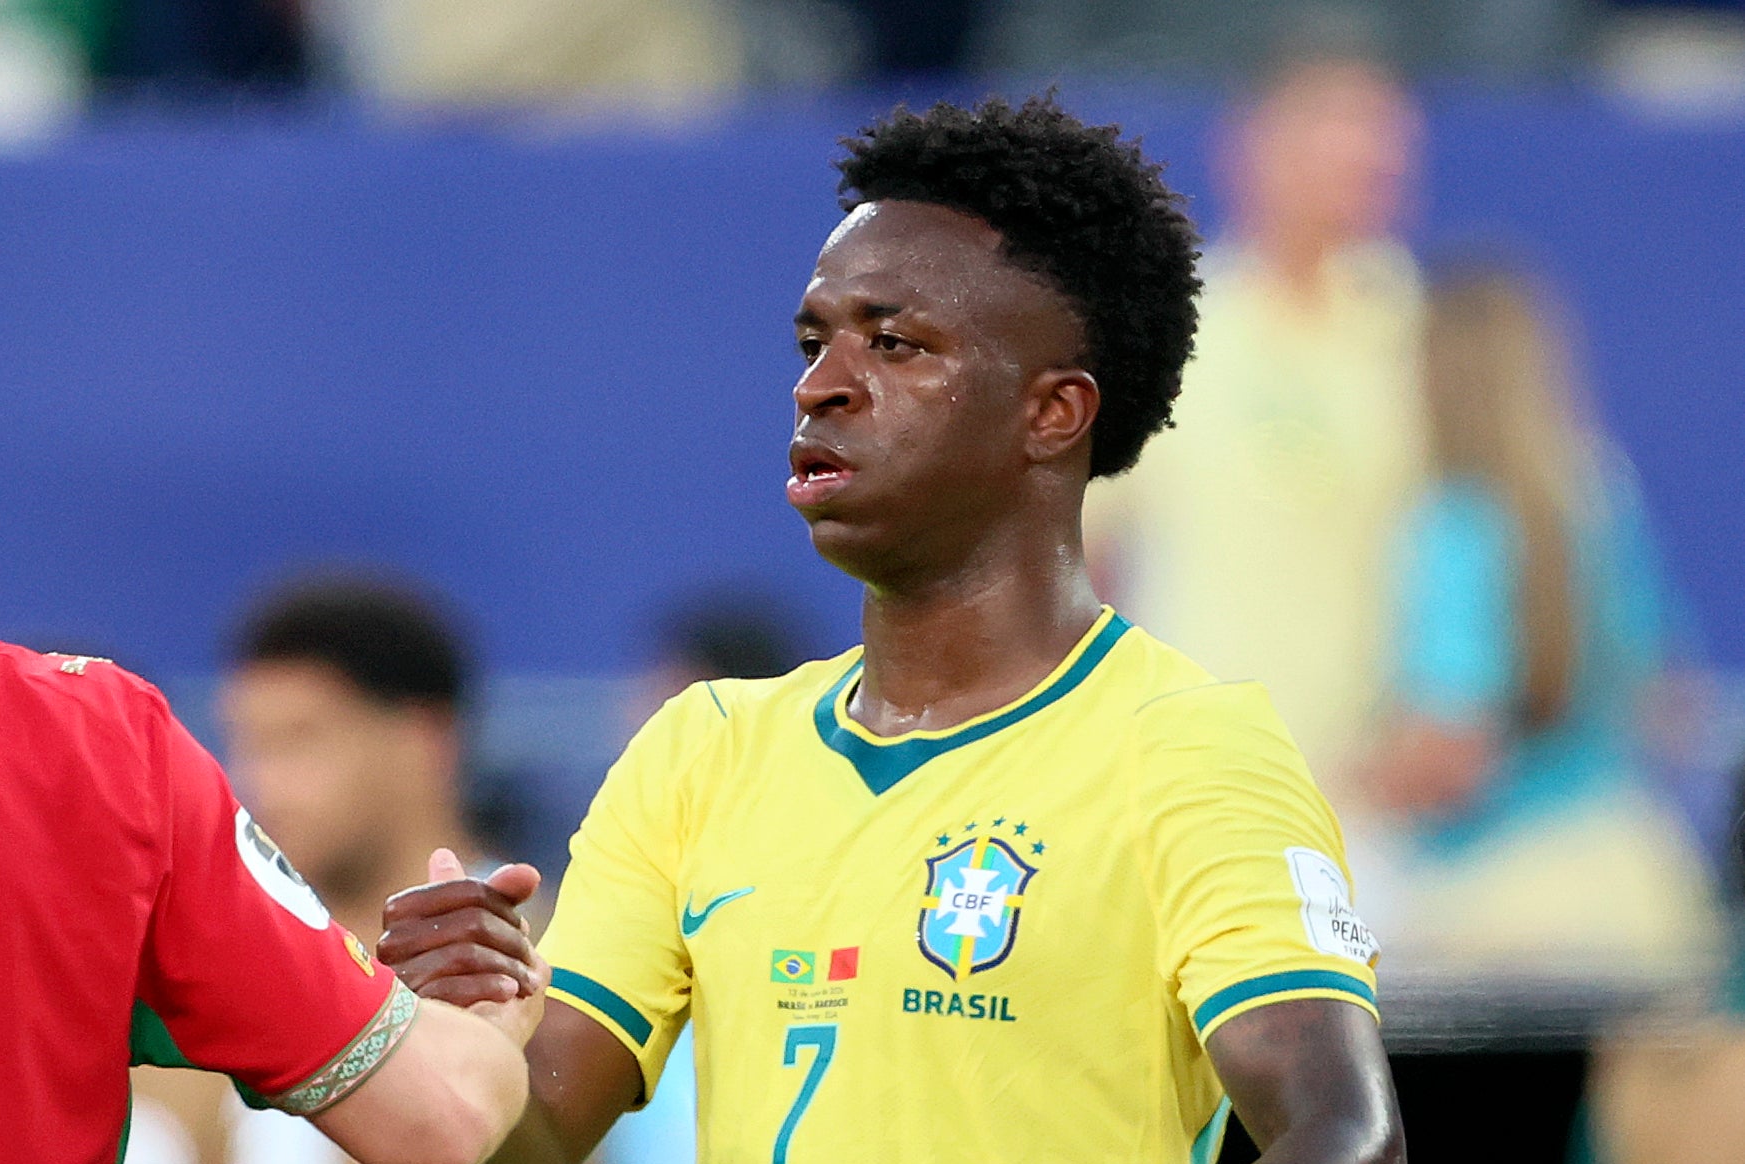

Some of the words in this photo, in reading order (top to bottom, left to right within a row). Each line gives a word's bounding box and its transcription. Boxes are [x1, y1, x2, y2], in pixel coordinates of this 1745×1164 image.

[952, 892, 993, 910] CBF
[1331, 919, 1373, 948] PEACE
[902, 987, 1017, 1022] BRASIL
